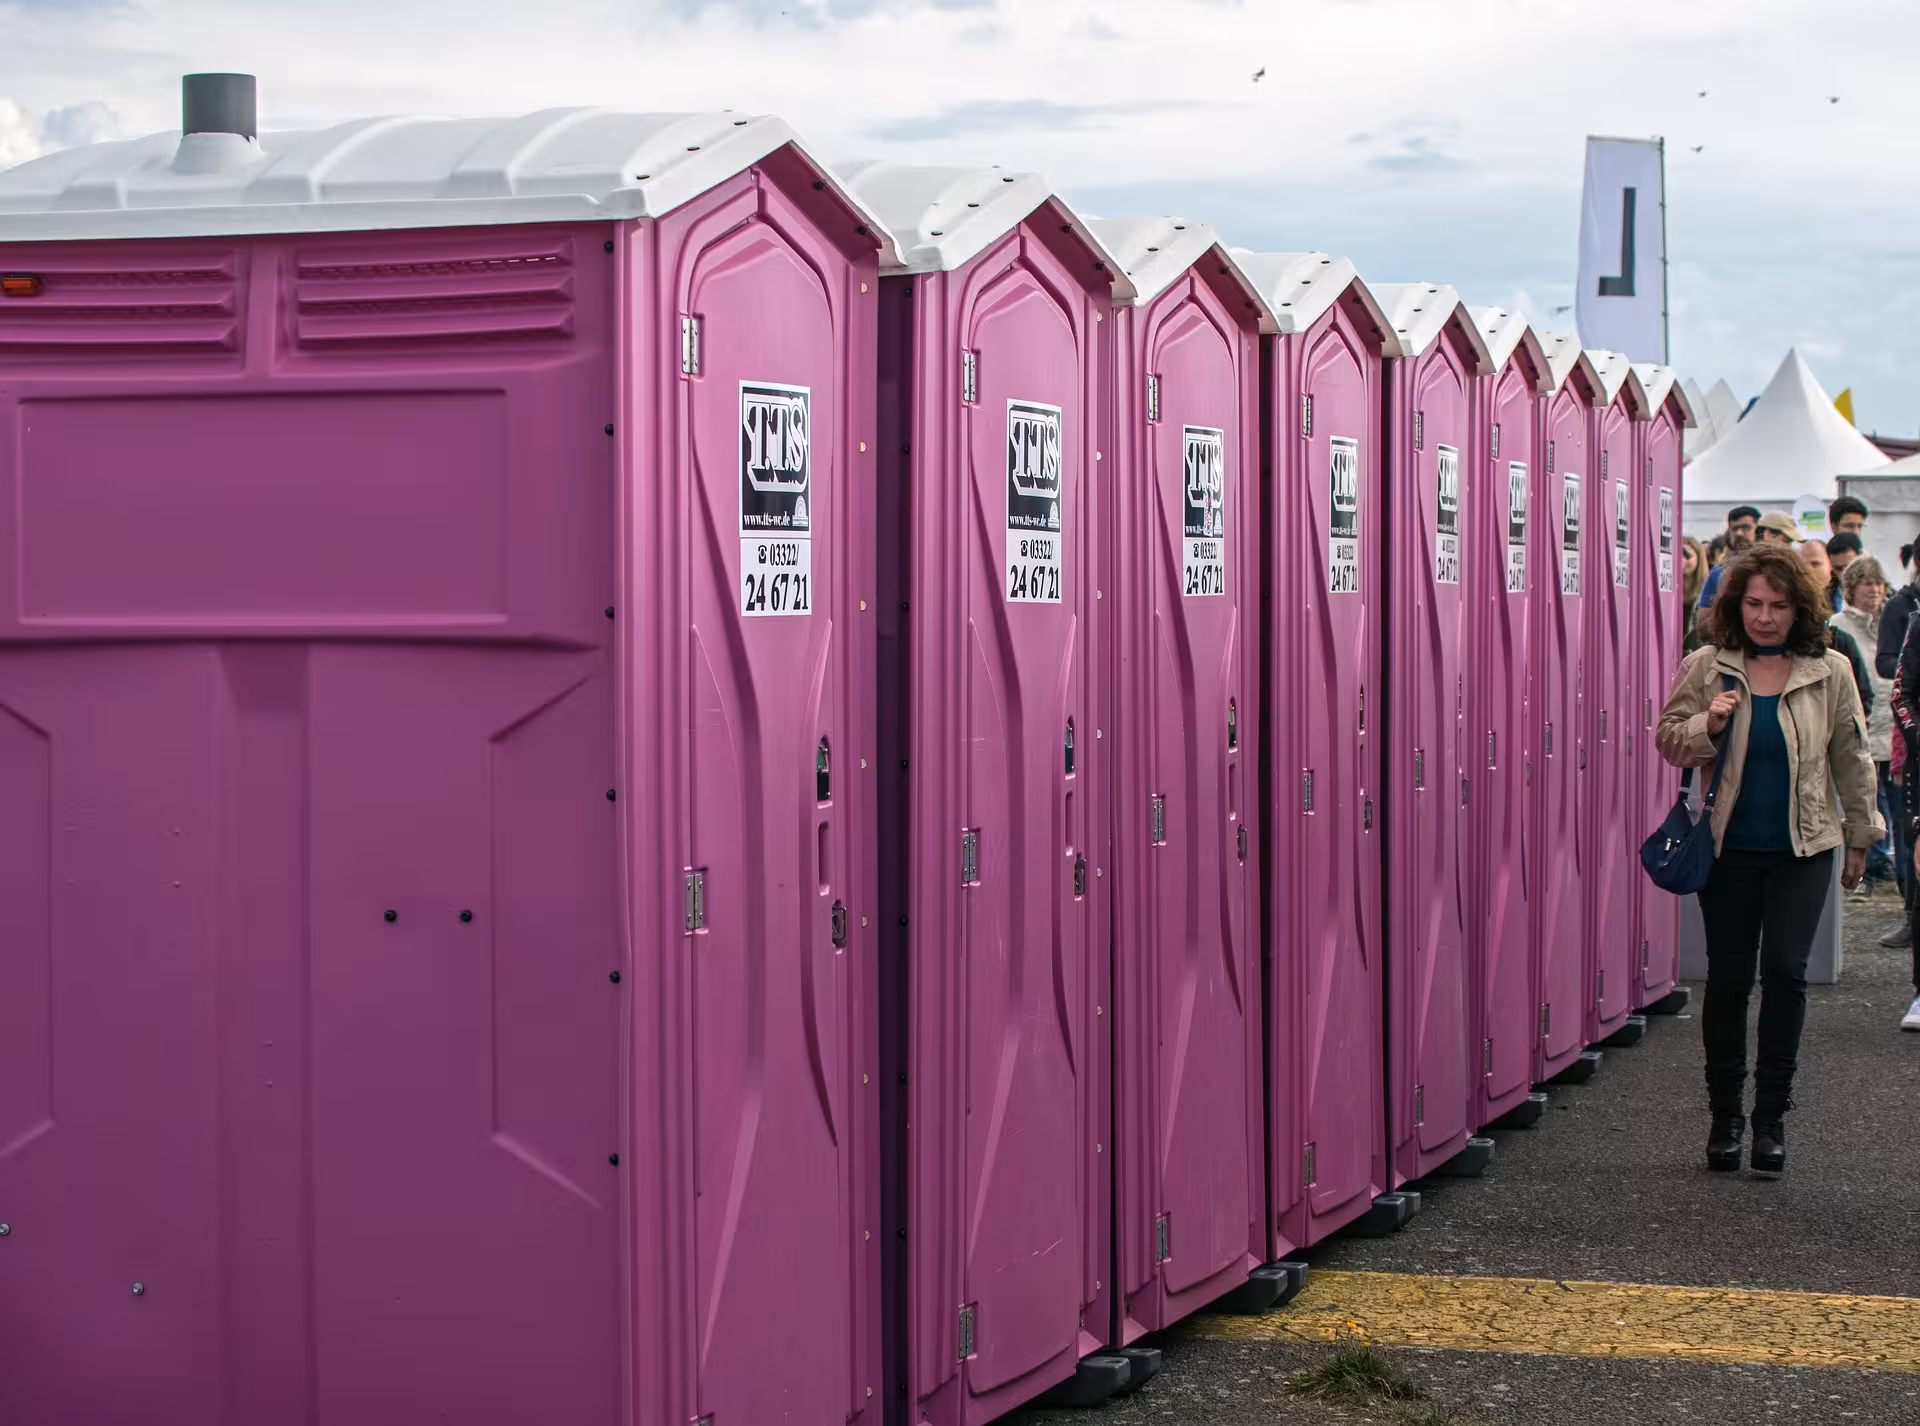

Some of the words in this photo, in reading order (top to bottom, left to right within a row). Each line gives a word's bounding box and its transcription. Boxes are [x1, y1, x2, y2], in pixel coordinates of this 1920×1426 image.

[744, 511, 791, 527] www.tts-wc.de
[1009, 513, 1047, 527] www.tts-wc.de
[769, 543, 799, 566] 03322/
[1010, 564, 1028, 598] 24
[1030, 565, 1046, 599] 67
[1047, 566, 1060, 600] 21
[1186, 565, 1199, 594] 24
[1201, 565, 1213, 594] 67
[1214, 565, 1224, 594] 21
[1331, 565, 1341, 591] 24
[1342, 565, 1351, 591] 67
[745, 573, 766, 612] 24
[770, 573, 790, 612] 67
[793, 573, 809, 611] 21
